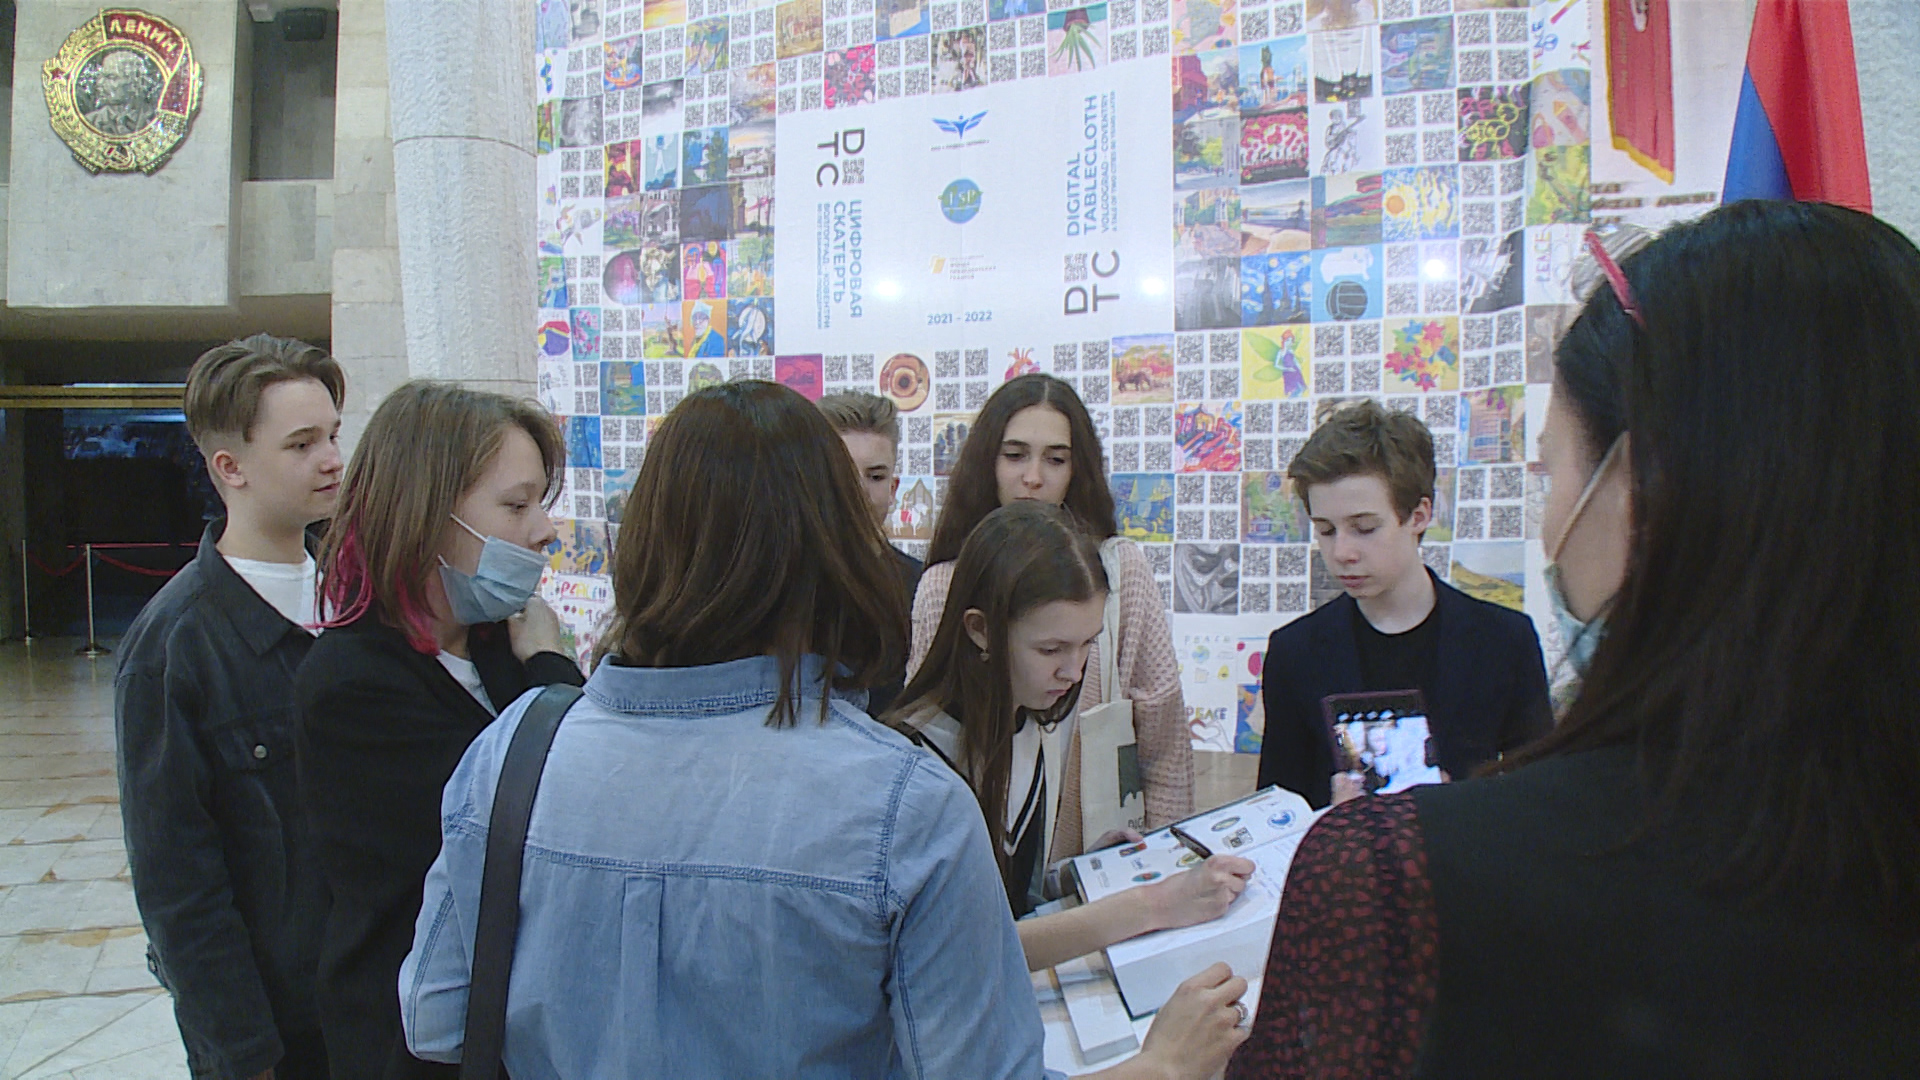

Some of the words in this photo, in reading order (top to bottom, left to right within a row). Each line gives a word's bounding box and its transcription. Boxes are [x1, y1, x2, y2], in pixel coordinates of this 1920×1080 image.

[109, 18, 178, 53] ЛЕНИН
[1100, 93, 1109, 152] COVENTRY
[1066, 152, 1080, 237] DIGITAL
[1083, 94, 1097, 236] TABLECLOTH
[1100, 161, 1109, 233] VOLGOGRAD
[833, 200, 846, 304] СКАТЕРТЬ
[847, 199, 862, 318] ЦИФРОВАЯ
[927, 312, 953, 325] 2021
[964, 310, 993, 323] 2022
[1185, 705, 1227, 721] PEACE
